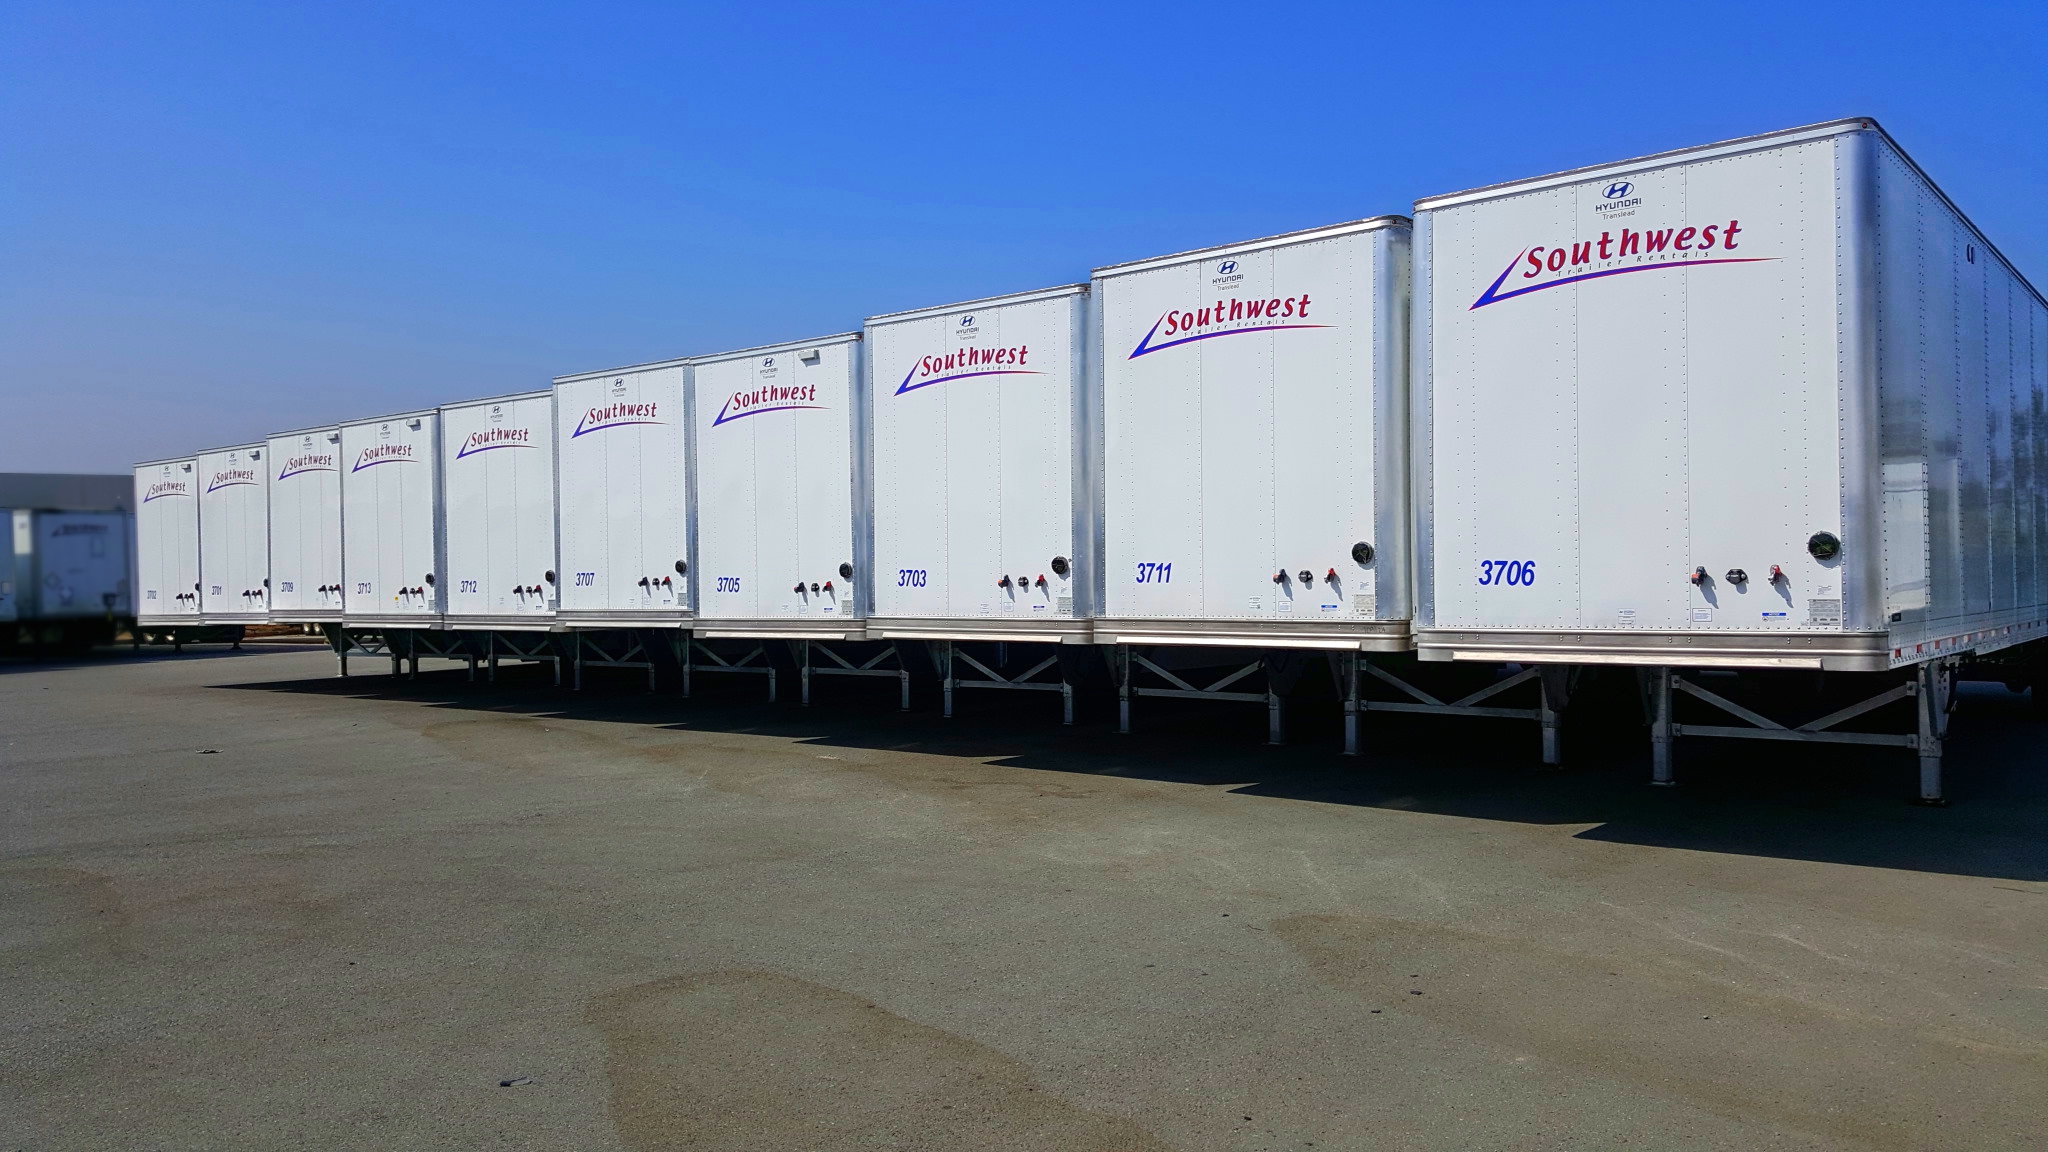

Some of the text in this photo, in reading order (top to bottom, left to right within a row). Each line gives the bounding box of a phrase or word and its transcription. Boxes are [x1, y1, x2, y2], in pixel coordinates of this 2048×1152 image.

[1595, 198, 1642, 212] HYUNDAI
[1603, 209, 1636, 220] Translead
[1523, 219, 1742, 279] Southwest
[1557, 251, 1710, 277] Trailer Rentals
[1212, 273, 1244, 284] HYUNDAI
[1164, 294, 1311, 336] Southwest
[920, 345, 1028, 377] Southwest
[732, 384, 816, 411] Southwest
[588, 402, 657, 424] Southwest
[470, 427, 528, 447] Southwest
[363, 443, 412, 461] Southwest
[289, 453, 332, 470] Southwest
[215, 469, 254, 483] Southwest
[151, 481, 186, 495] Southwest
[575, 572, 595, 586] 3707
[898, 569, 927, 587] 3703
[1136, 562, 1172, 583] 3711
[1478, 559, 1536, 587] 3706
[211, 585, 222, 595] 3701
[281, 581, 293, 592] 3709
[357, 582, 371, 594] 3713
[460, 580, 477, 593] 3712
[716, 577, 740, 593] 3705
